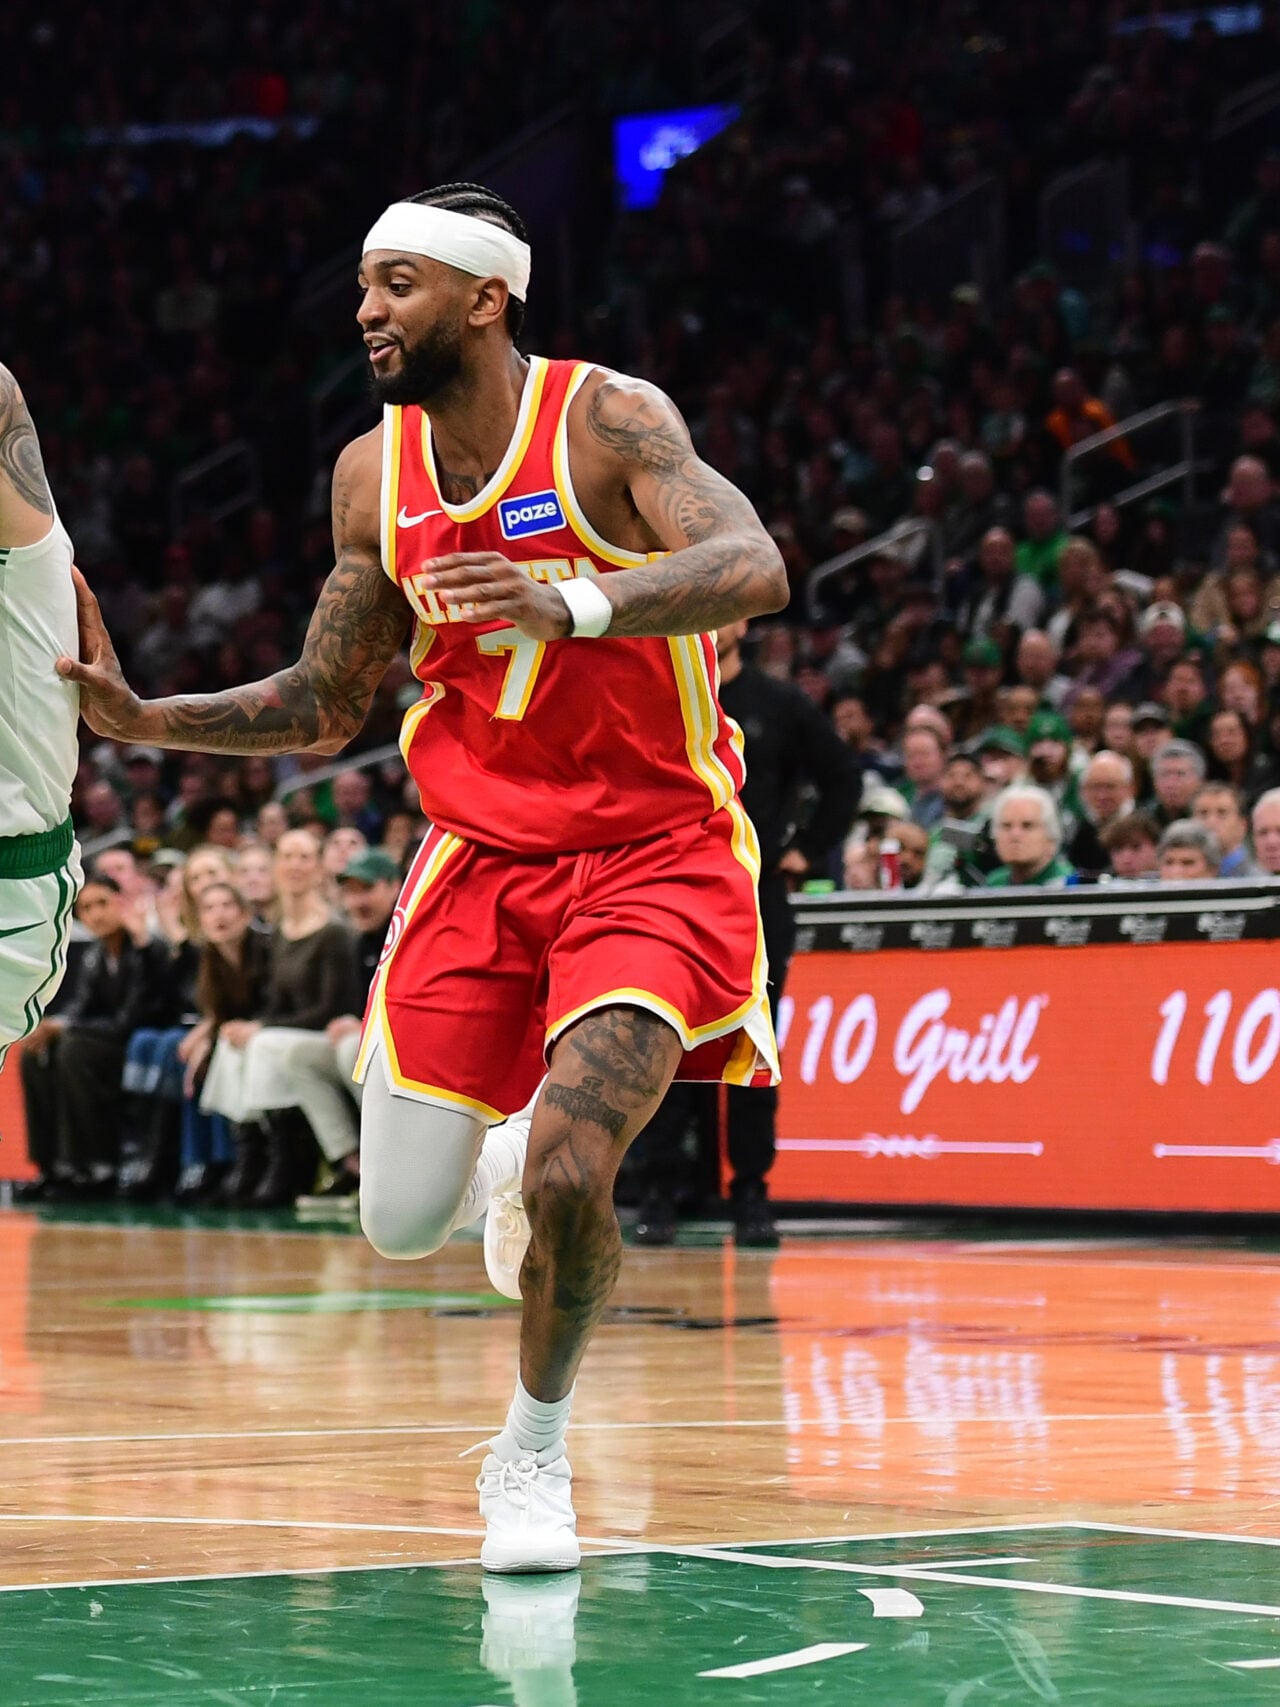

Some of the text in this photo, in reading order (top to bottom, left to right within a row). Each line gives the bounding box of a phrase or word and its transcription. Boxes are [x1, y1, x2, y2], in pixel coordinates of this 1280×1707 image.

[505, 501, 558, 530] paze
[475, 626, 547, 721] 7
[893, 988, 1041, 1115] Grill
[1151, 987, 1280, 1086] 110
